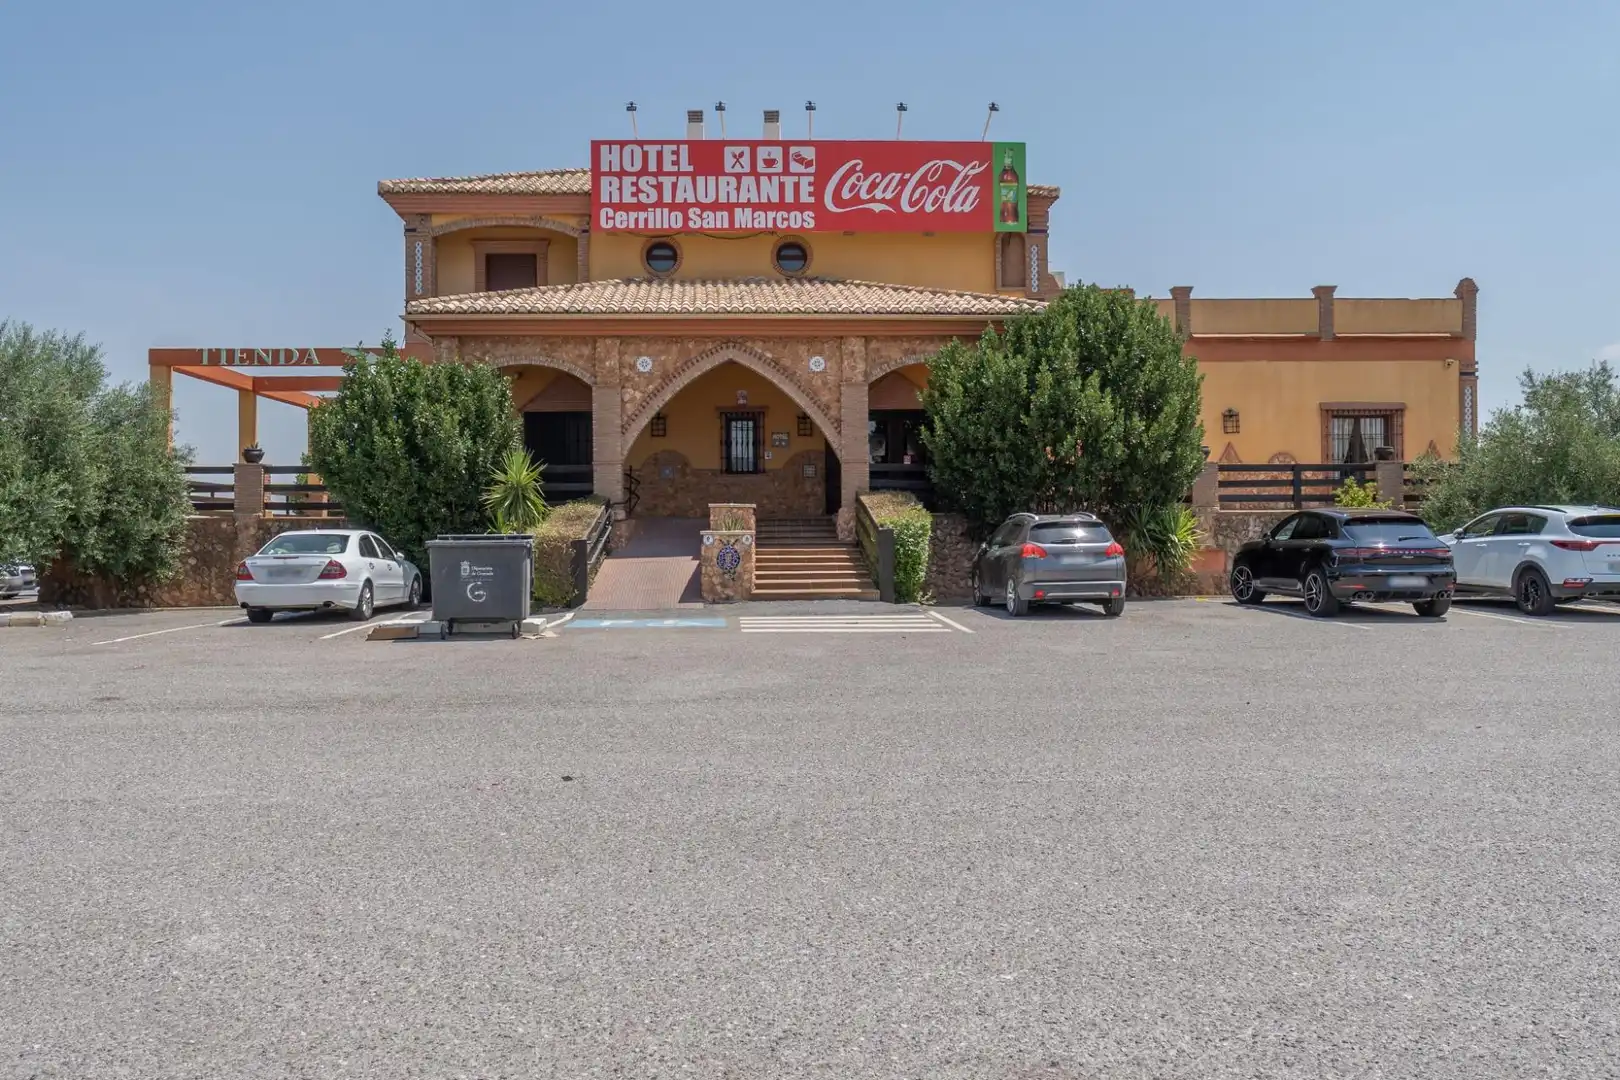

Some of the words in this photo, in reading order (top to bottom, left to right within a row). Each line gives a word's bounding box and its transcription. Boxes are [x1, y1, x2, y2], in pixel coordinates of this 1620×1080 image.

[600, 144, 694, 172] HOTEL
[600, 176, 815, 203] RESTAURANTE
[824, 159, 991, 213] Coca-Cola
[600, 207, 683, 229] Cerrillo
[688, 207, 730, 229] San
[734, 207, 815, 229] Marcos
[197, 348, 321, 365] TIENDA
